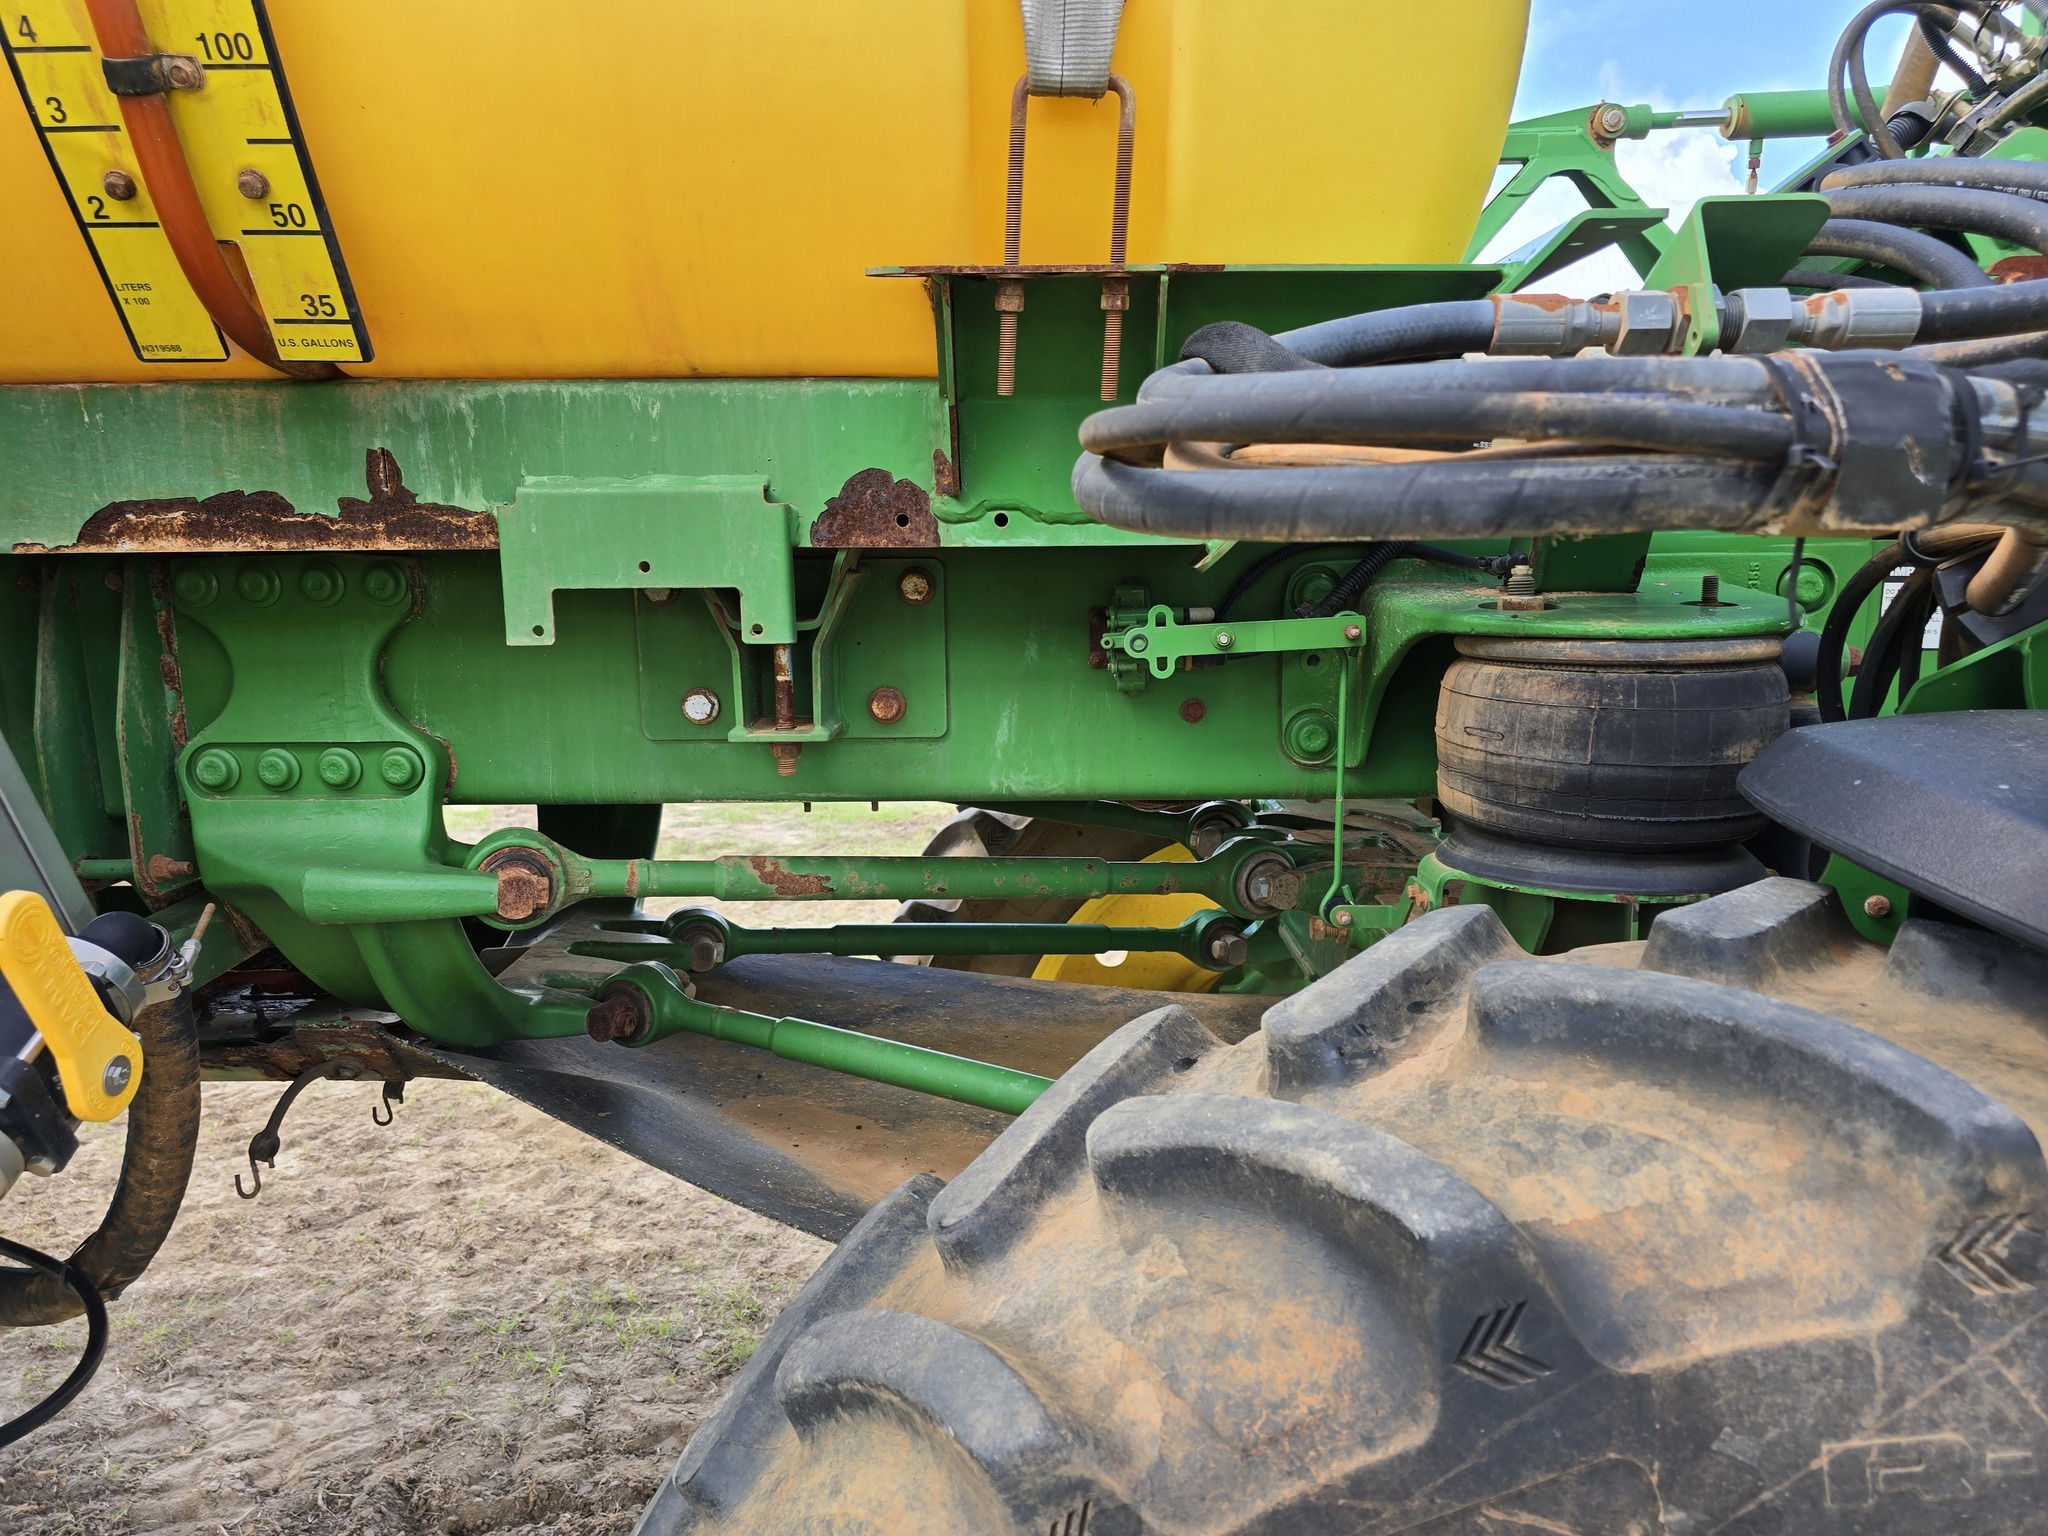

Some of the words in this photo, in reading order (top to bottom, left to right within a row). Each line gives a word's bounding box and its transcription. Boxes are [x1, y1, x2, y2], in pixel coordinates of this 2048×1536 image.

[18, 15, 38, 43] 4
[195, 32, 253, 61] 100
[46, 97, 67, 123] 3
[87, 196, 110, 220] 2
[269, 203, 306, 228] 50
[115, 283, 152, 292] LITERS
[133, 297, 151, 306] 100
[300, 294, 336, 317] 35
[141, 344, 183, 353] N319588
[278, 338, 299, 348] U.S.
[301, 338, 354, 349] GALLONS
